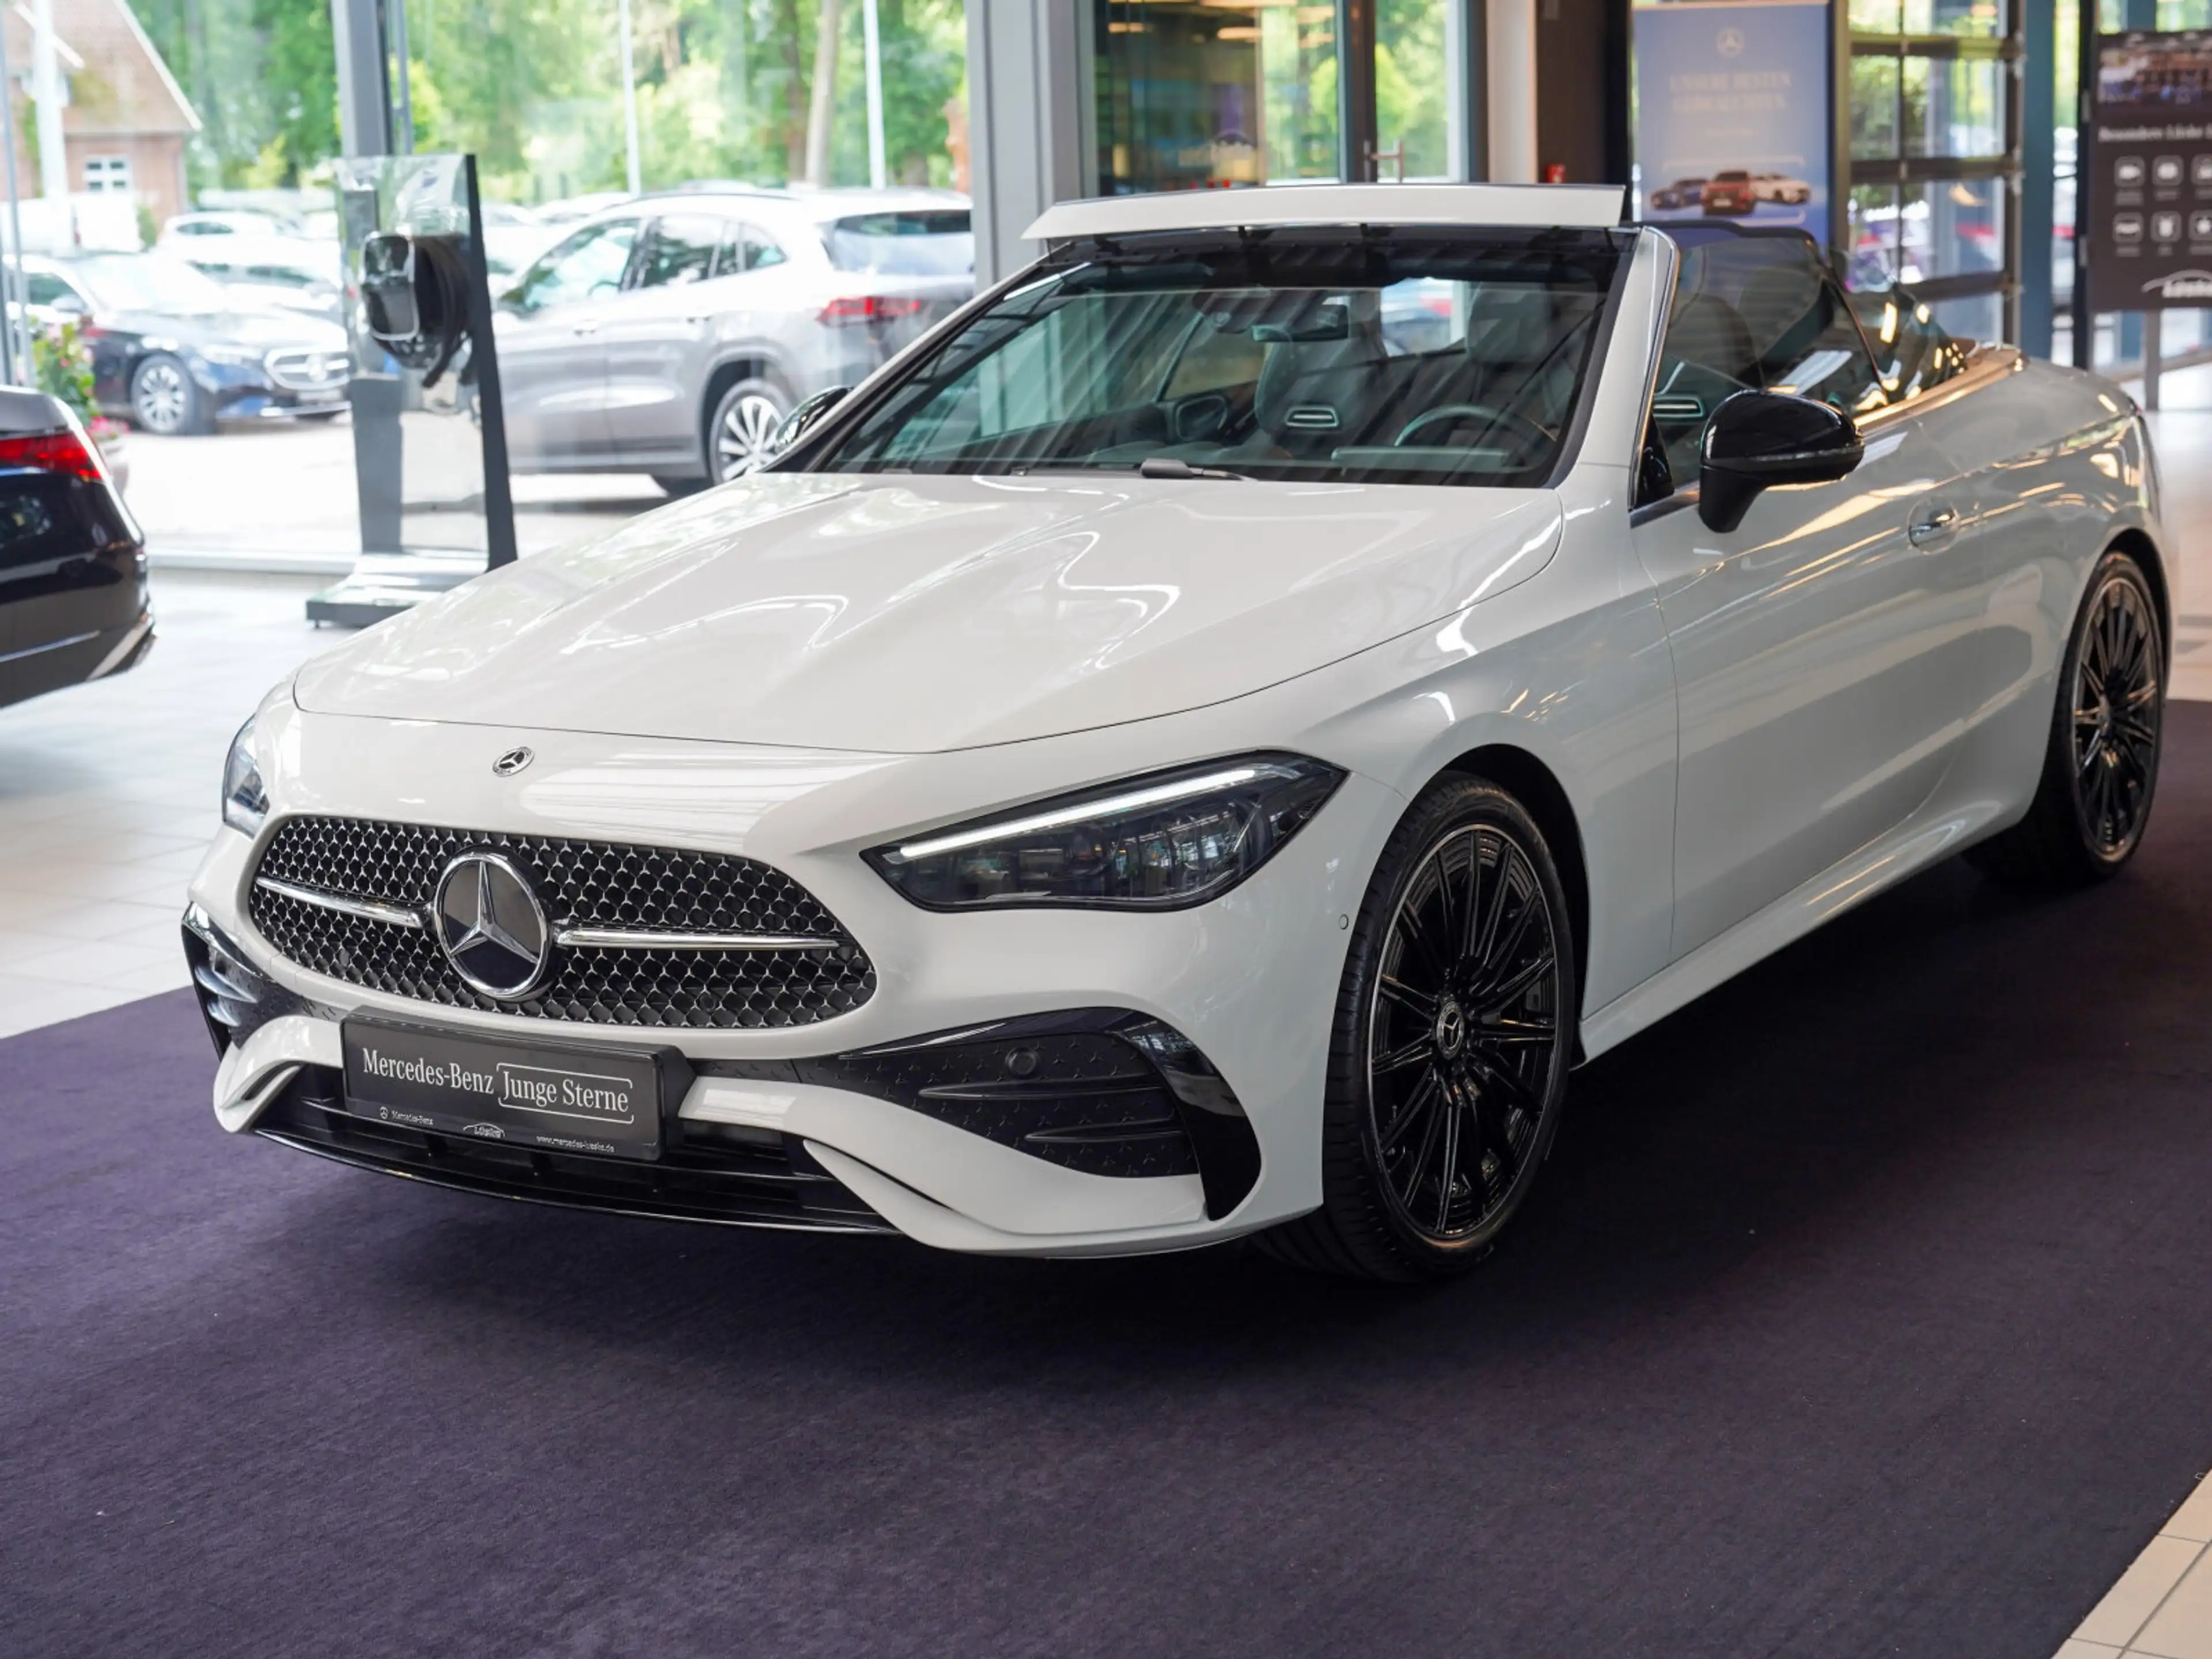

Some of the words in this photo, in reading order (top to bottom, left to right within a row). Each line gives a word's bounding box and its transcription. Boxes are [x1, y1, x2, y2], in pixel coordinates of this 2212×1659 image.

[362, 1048, 494, 1094] Mercedes-Benz
[502, 1071, 557, 1107] Junge
[562, 1078, 629, 1113] Sterne
